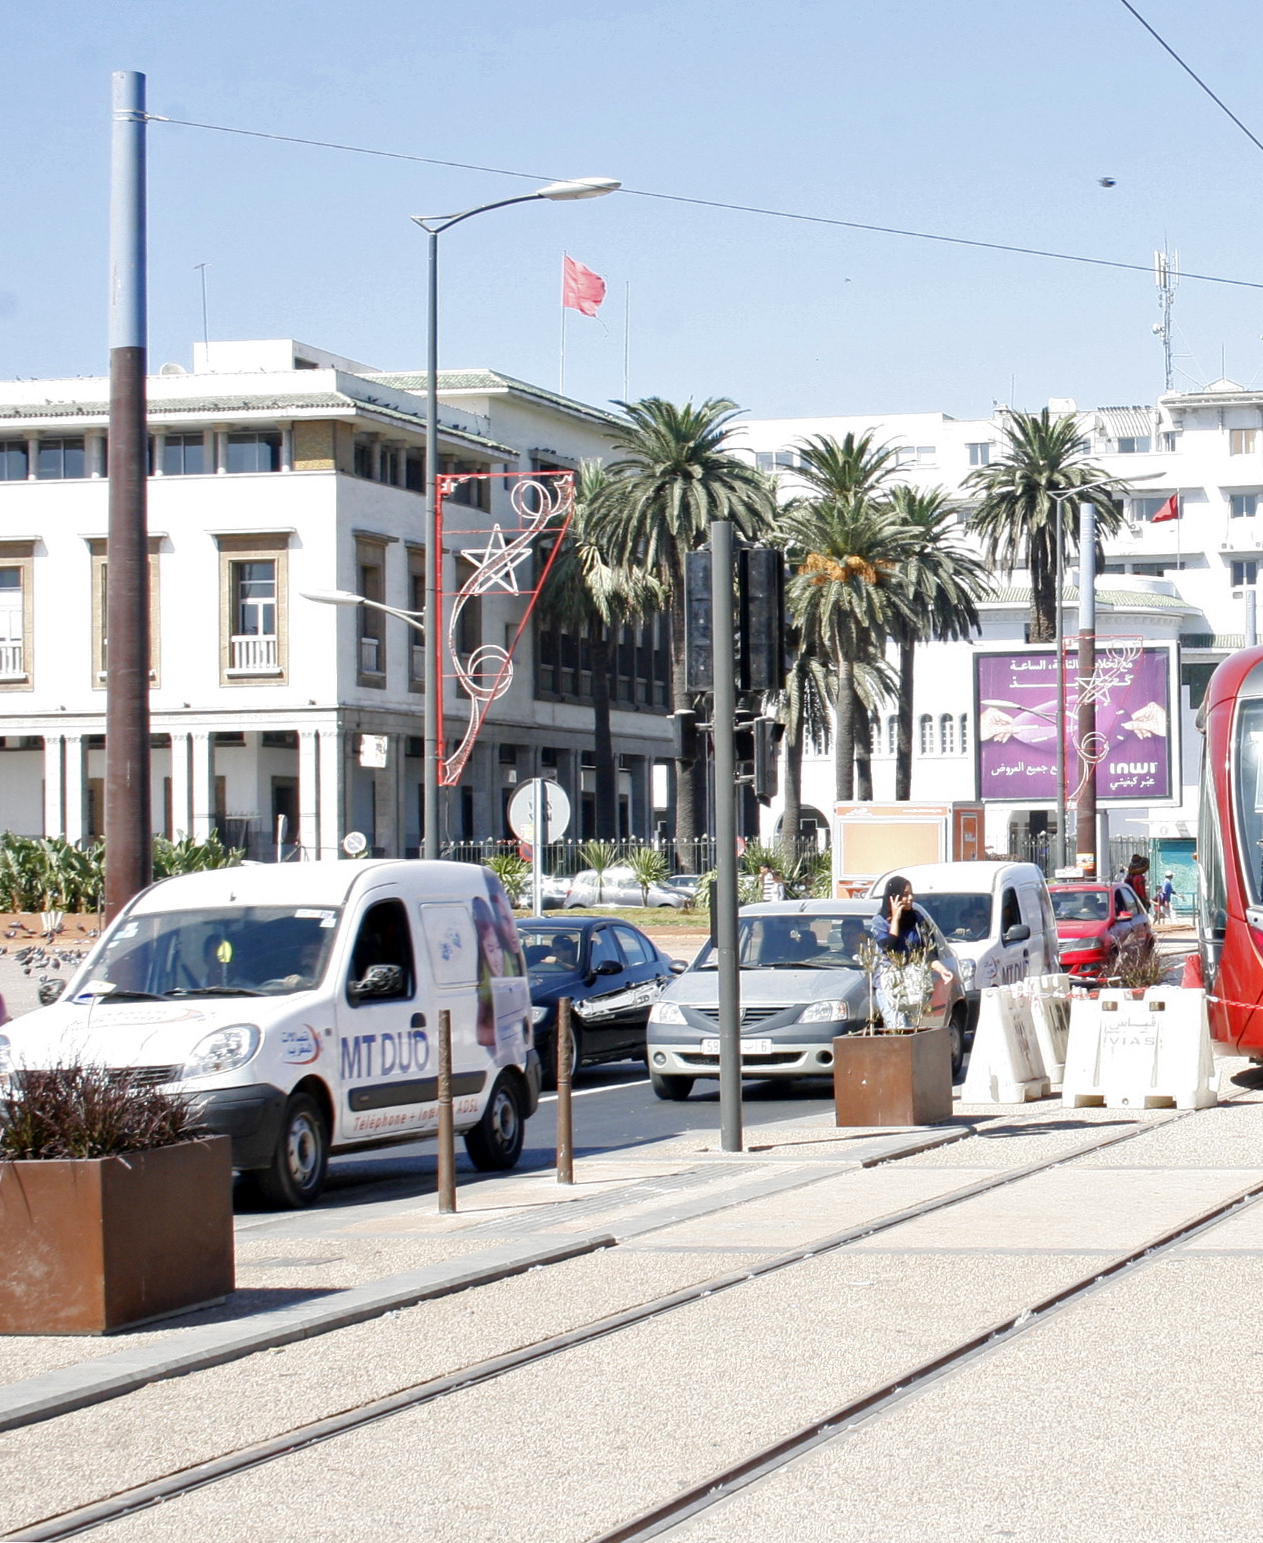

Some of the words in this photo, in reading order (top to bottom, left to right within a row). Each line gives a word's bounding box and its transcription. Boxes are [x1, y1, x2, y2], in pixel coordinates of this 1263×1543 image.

[1109, 1036, 1156, 1046] VIAS
[341, 1035, 376, 1079] MT
[381, 1030, 429, 1075] DUO
[456, 1099, 479, 1114] ADSL
